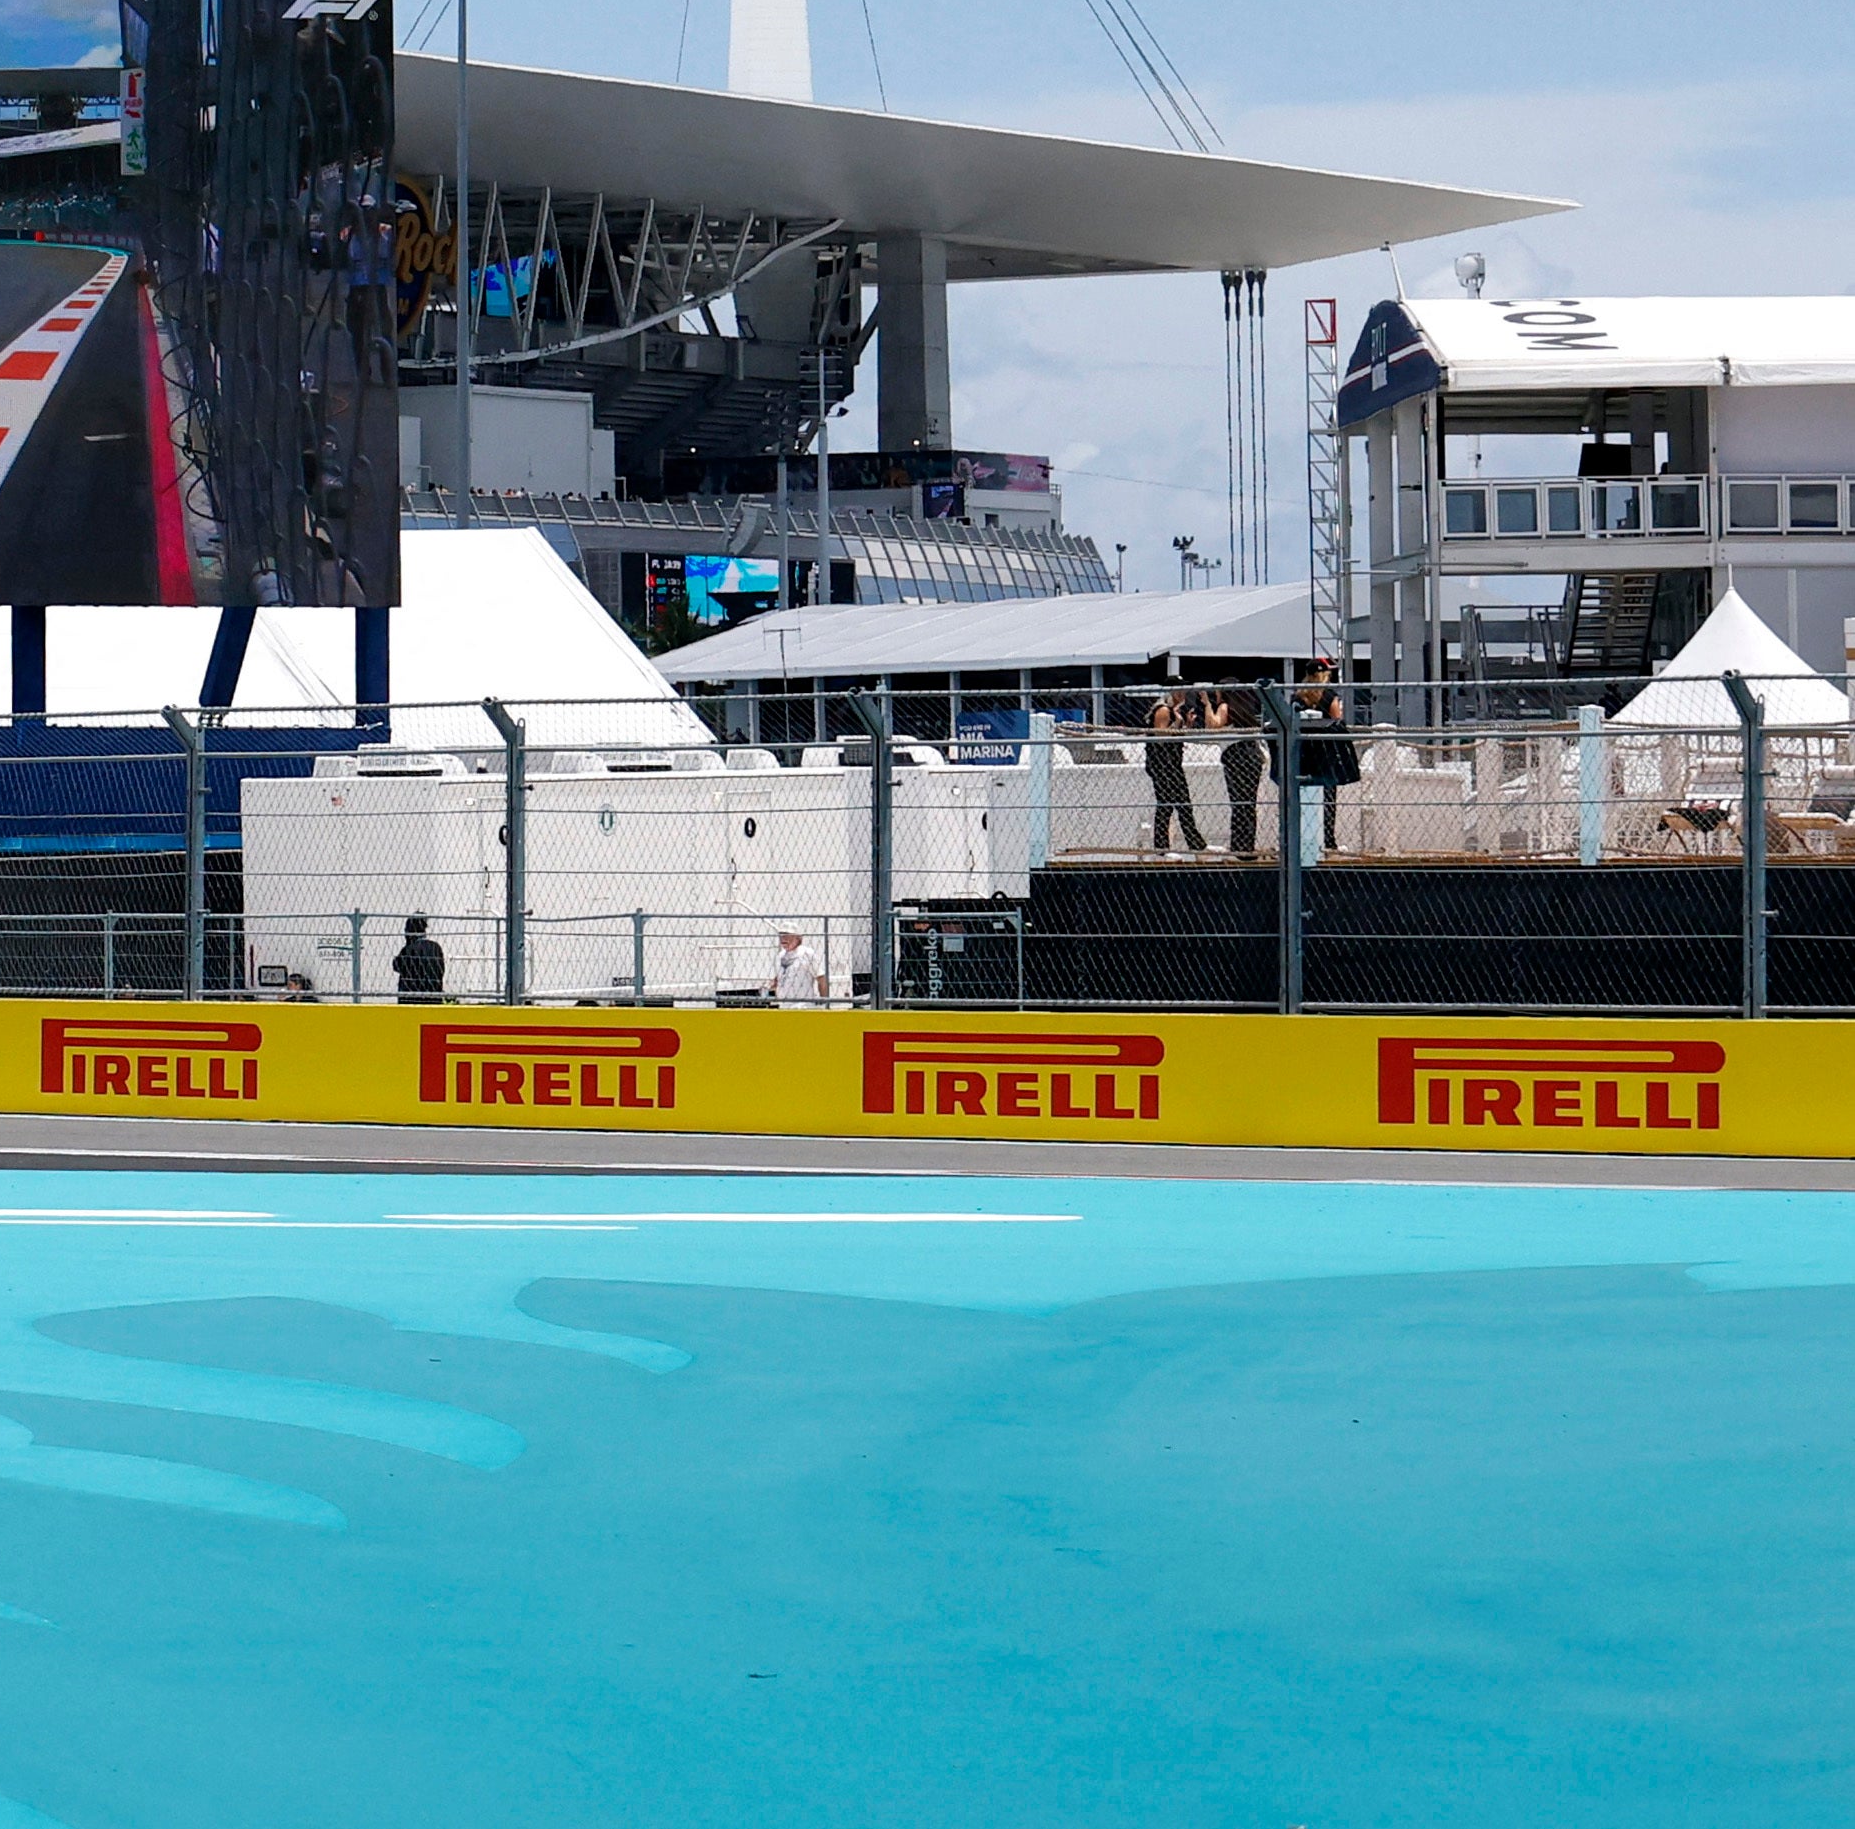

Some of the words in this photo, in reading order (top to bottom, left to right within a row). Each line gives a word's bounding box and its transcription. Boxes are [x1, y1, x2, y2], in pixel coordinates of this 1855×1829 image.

[959, 731, 985, 742] MIA
[960, 745, 1015, 759] MARINA
[41, 1018, 262, 1100] PIRELLI
[419, 1024, 681, 1109] PIRELLI
[863, 1032, 1165, 1120] PIRELLI
[1378, 1038, 1726, 1129] PIRELLI
